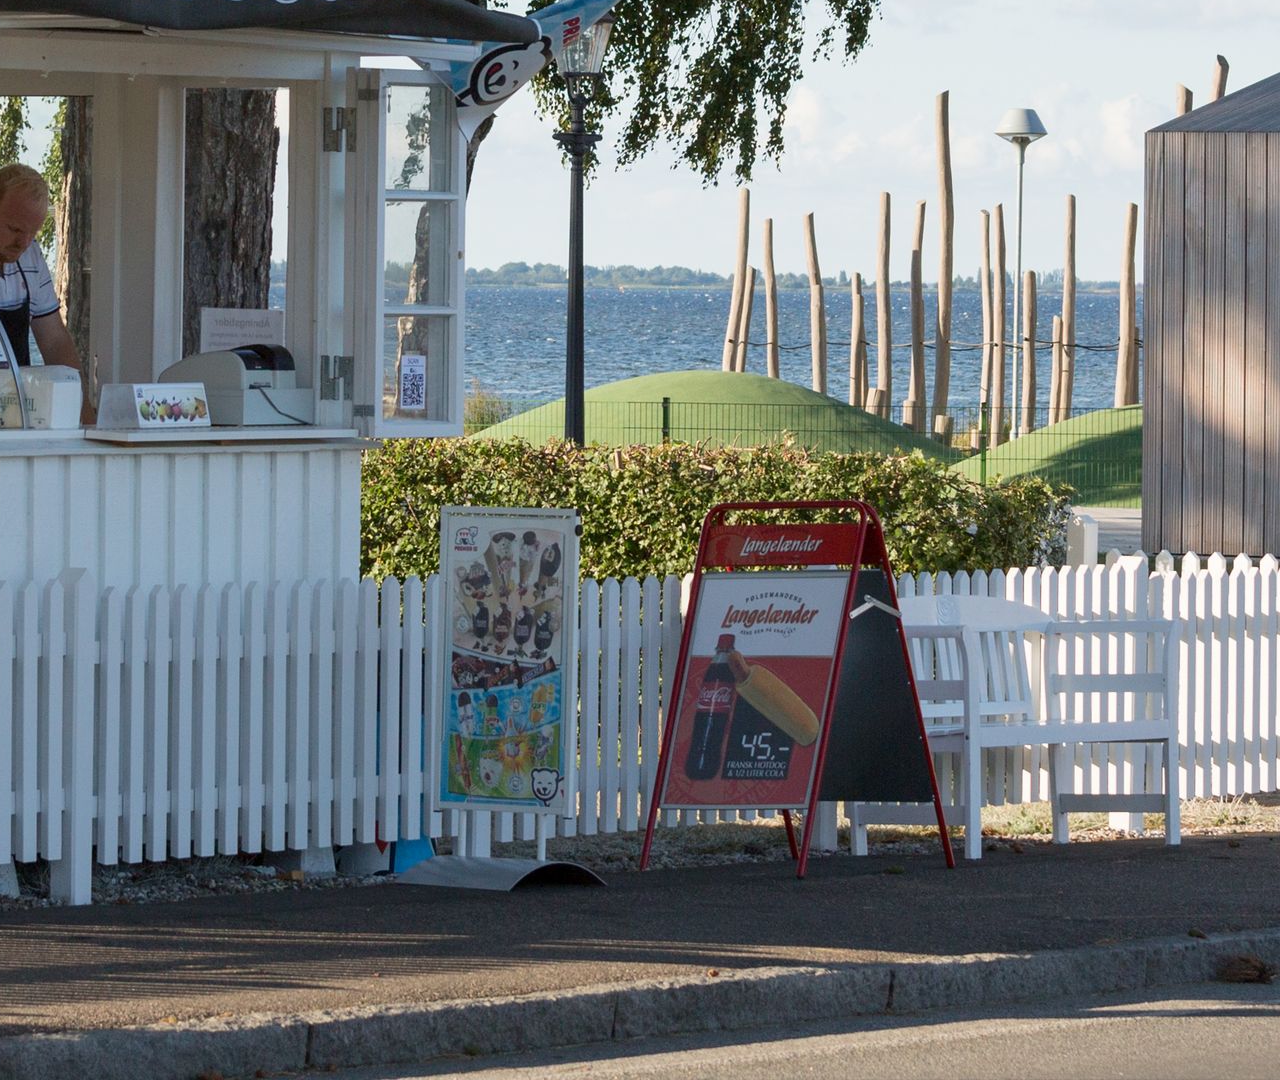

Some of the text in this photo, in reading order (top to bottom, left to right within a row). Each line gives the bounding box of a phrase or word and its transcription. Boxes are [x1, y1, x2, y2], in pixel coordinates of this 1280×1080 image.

[739, 534, 823, 557] Langelænder
[745, 591, 803, 604] PØLSEMANDENS
[721, 603, 820, 628] Langelænder
[727, 761, 787, 769] FRANSK HOTDOG
[727, 769, 784, 777] & 1/2 LITER COLA
